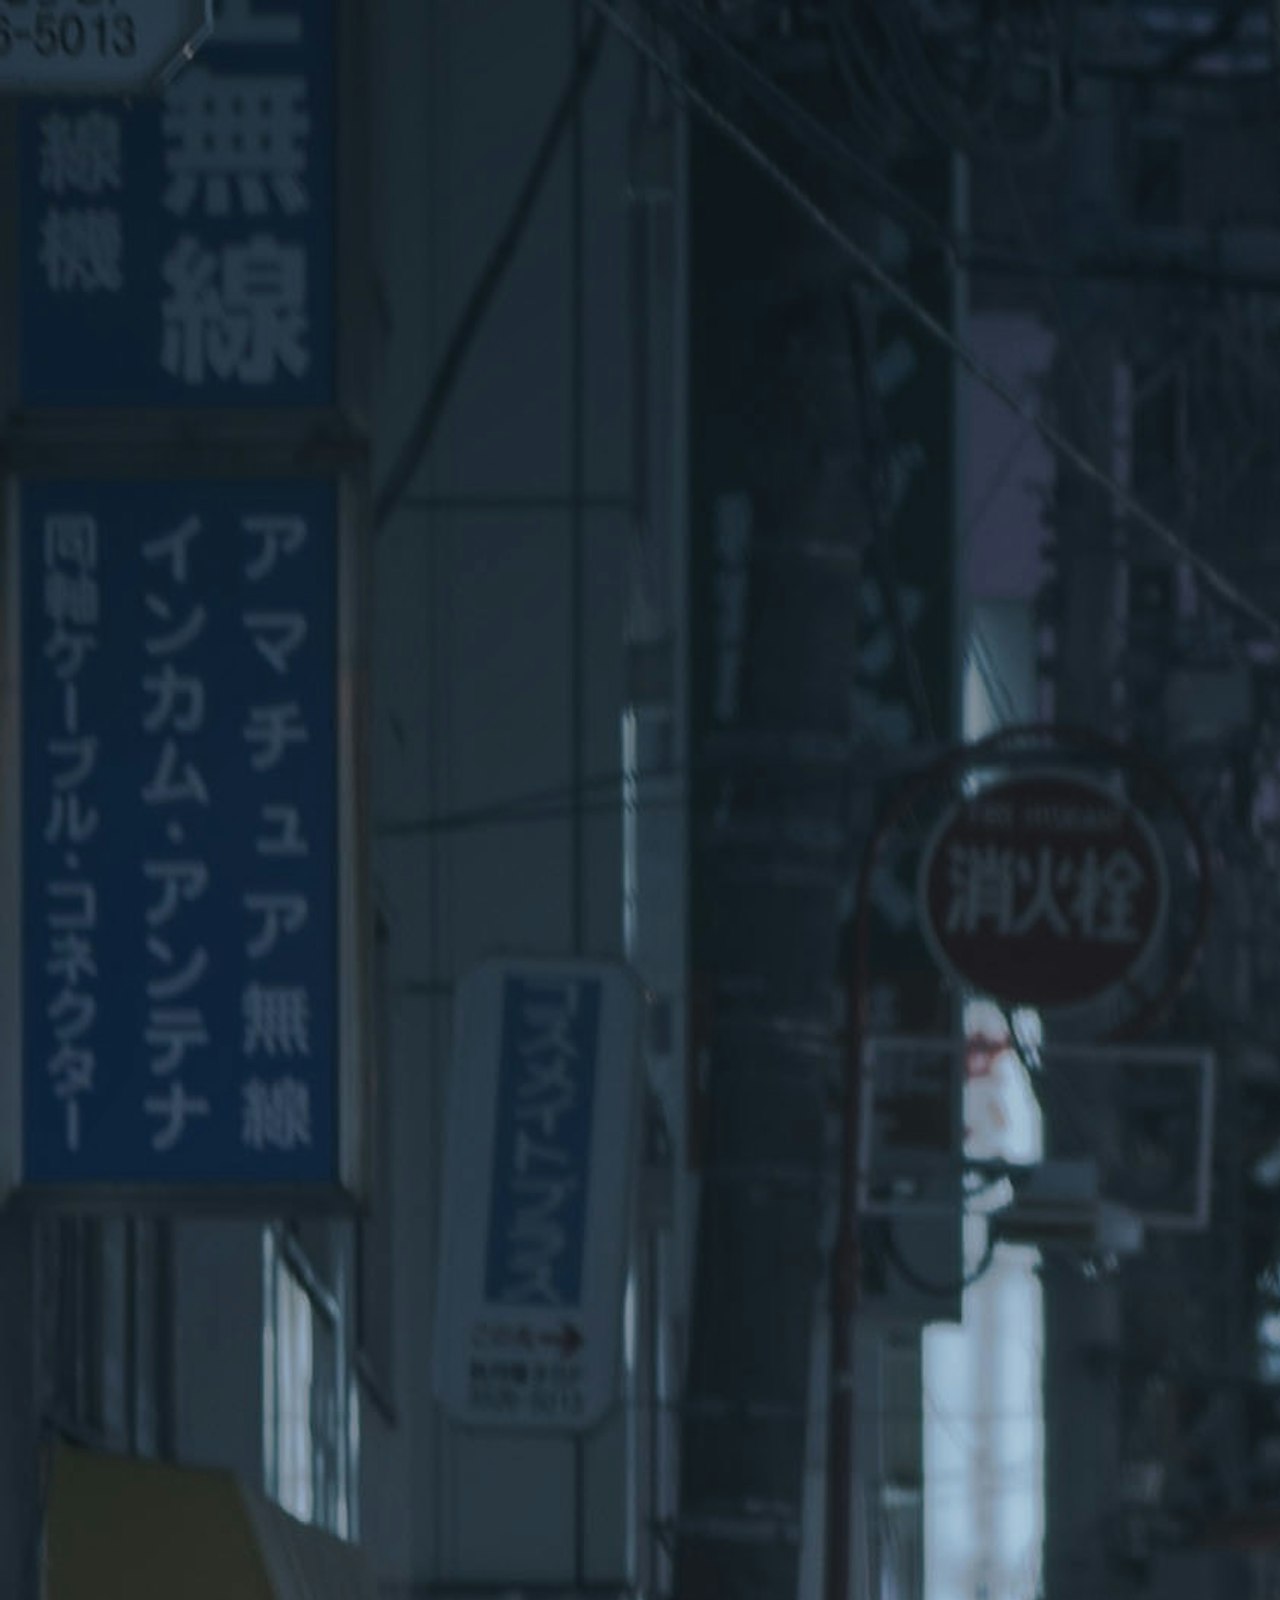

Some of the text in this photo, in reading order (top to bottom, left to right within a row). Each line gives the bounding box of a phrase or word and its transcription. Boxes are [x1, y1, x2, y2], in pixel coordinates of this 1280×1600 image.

[141, 514, 210, 1153] インカム・アンテナ
[240, 513, 312, 1151] アマチュア無線
[945, 843, 1145, 944] 消火栓
